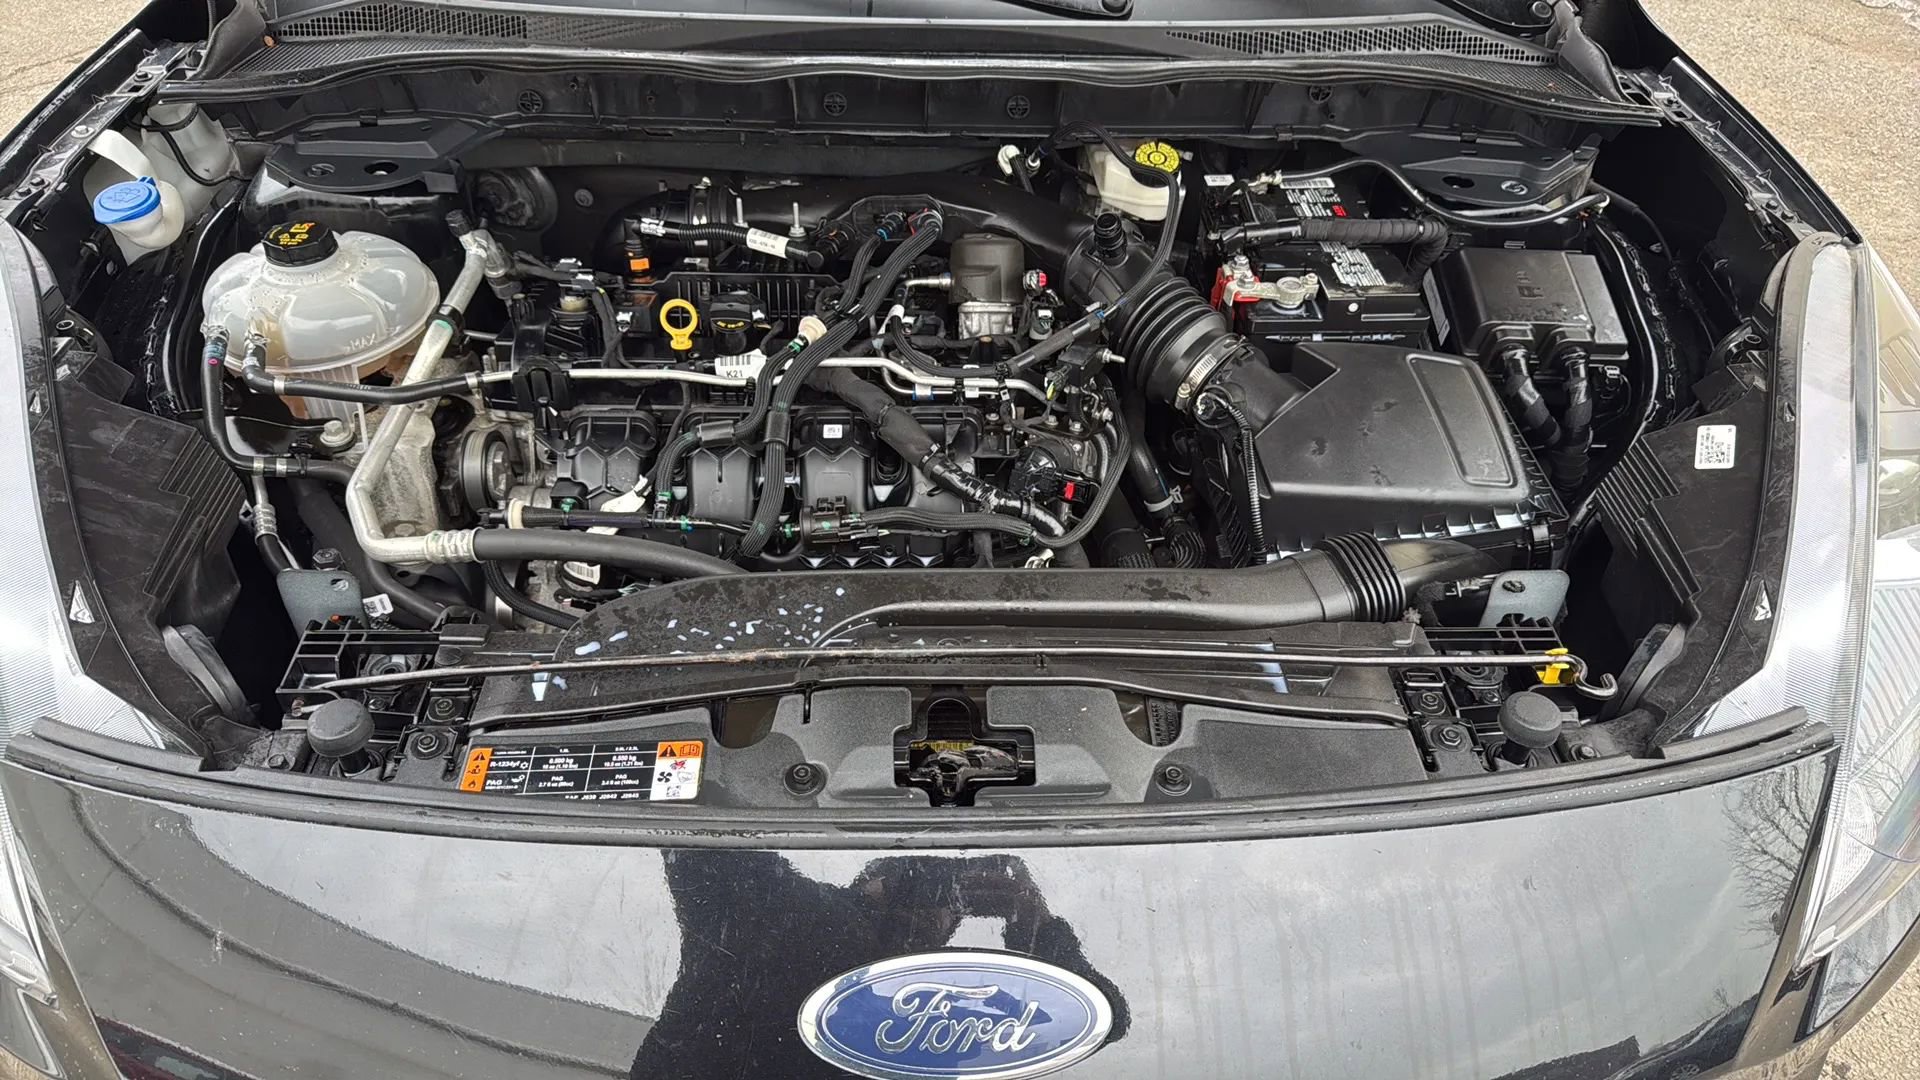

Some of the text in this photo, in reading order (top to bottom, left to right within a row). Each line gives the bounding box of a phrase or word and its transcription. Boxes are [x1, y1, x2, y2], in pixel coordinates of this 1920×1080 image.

[726, 370, 743, 378] K21
[490, 760, 520, 768] R-1234yf
[875, 982, 1039, 1052] Ford
